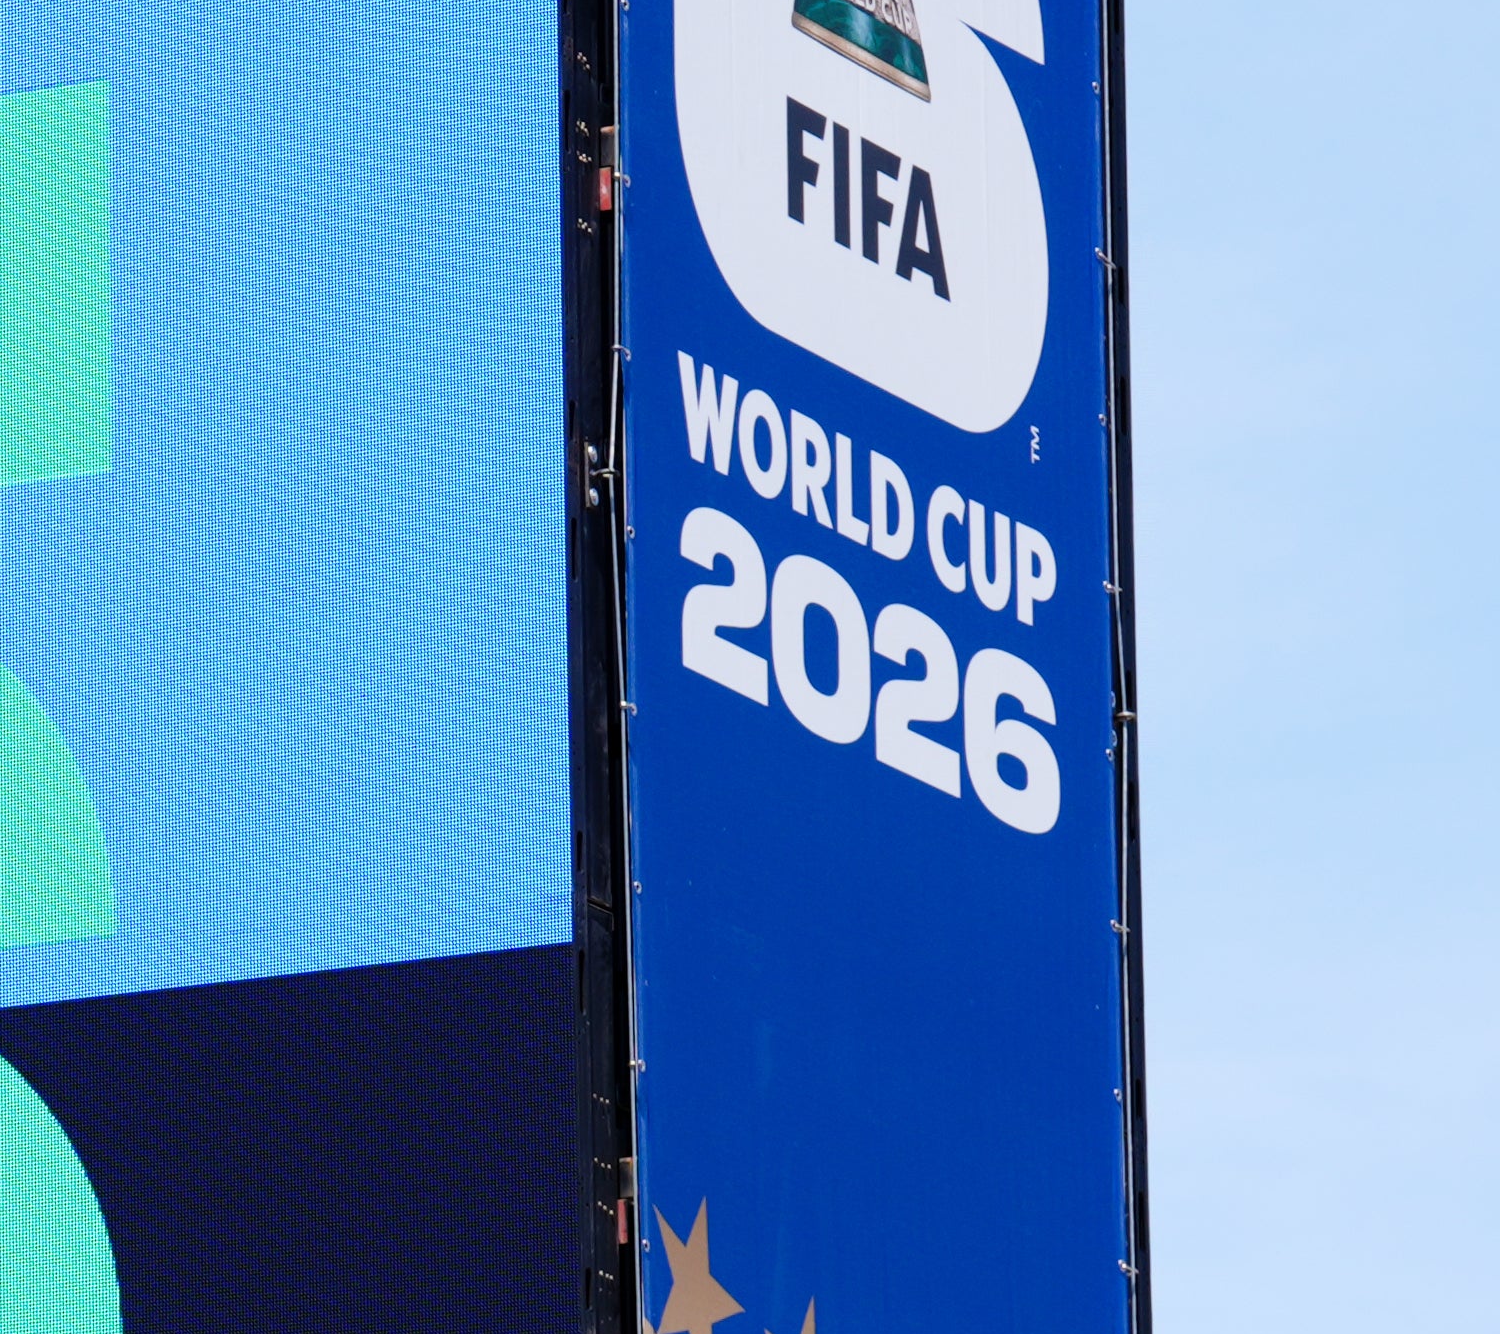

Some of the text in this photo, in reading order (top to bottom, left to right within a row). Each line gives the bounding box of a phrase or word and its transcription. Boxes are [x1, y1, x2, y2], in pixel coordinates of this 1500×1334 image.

[786, 96, 950, 303] FIFA
[677, 350, 1057, 627] WORLD CUP
[680, 507, 1061, 835] 2026
